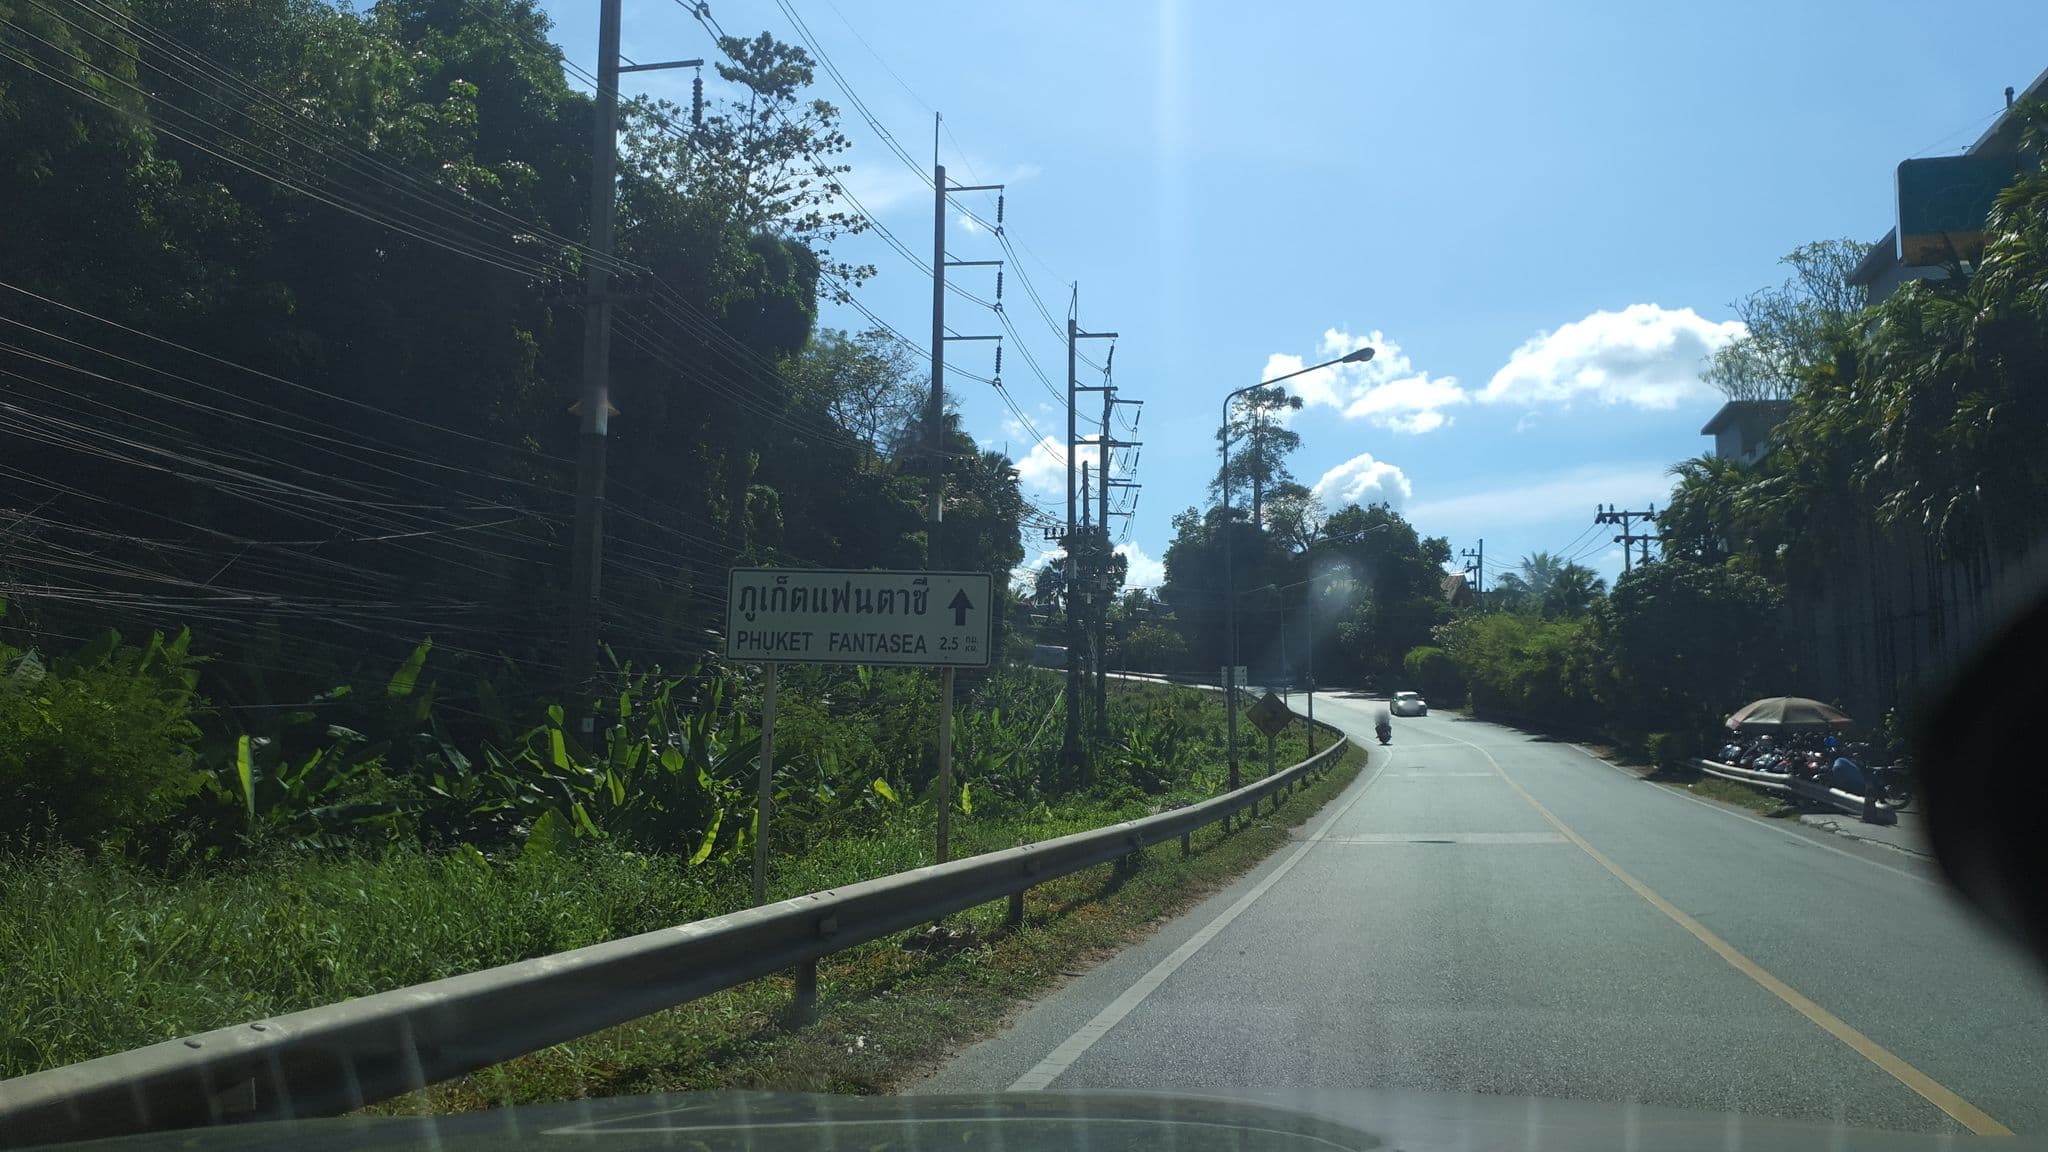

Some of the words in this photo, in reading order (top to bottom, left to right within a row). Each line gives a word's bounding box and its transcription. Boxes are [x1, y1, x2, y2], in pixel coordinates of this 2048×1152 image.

[738, 576, 929, 621] ภูเก็ตแฟนตาซี
[737, 631, 814, 652] PHUKET
[828, 632, 928, 654] FANTASEA
[939, 636, 959, 650] 2.5
